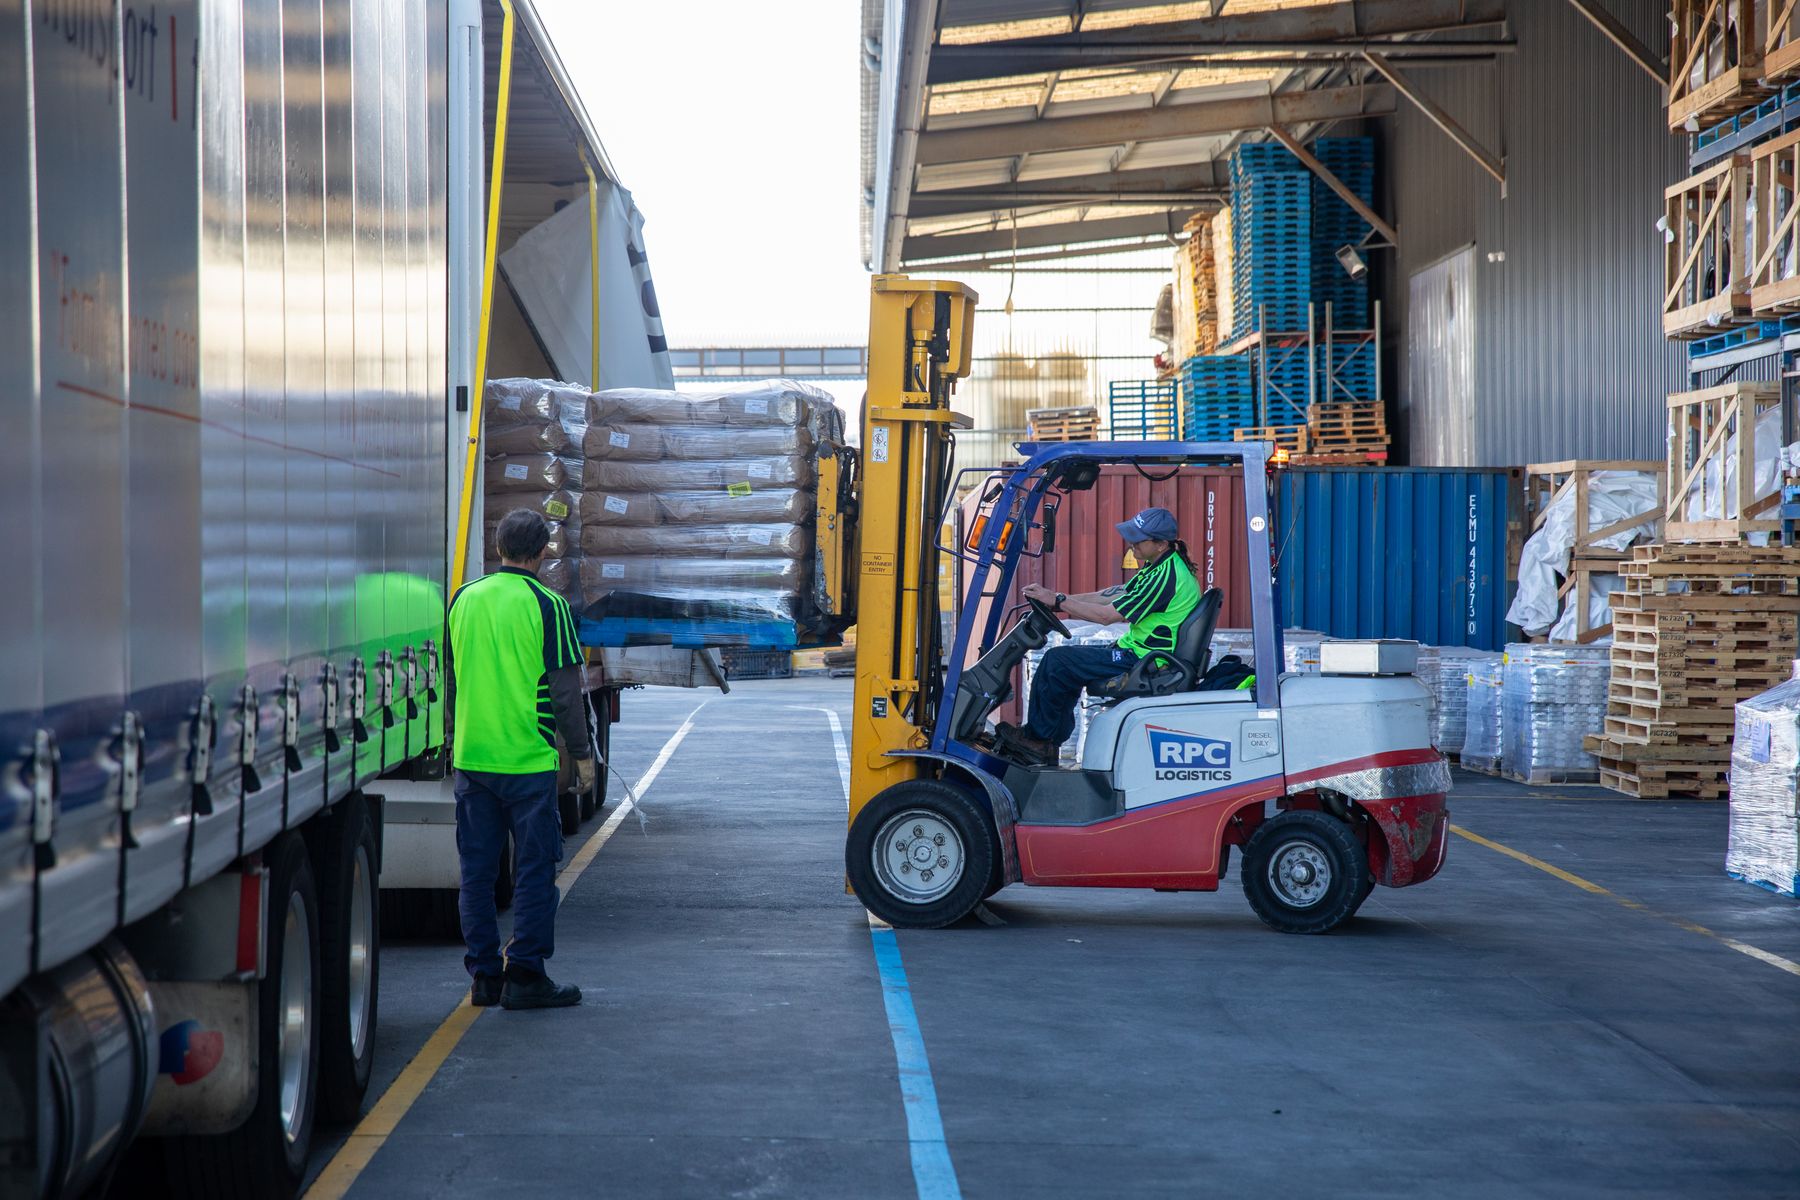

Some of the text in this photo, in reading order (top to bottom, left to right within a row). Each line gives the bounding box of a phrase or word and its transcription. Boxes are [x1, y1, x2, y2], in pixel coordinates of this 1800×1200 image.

[1208, 491, 1216, 542] DRYU
[1469, 495, 1477, 542] ECMU
[1159, 741, 1227, 766] RPC
[1155, 770, 1232, 781] LOGISTICS
